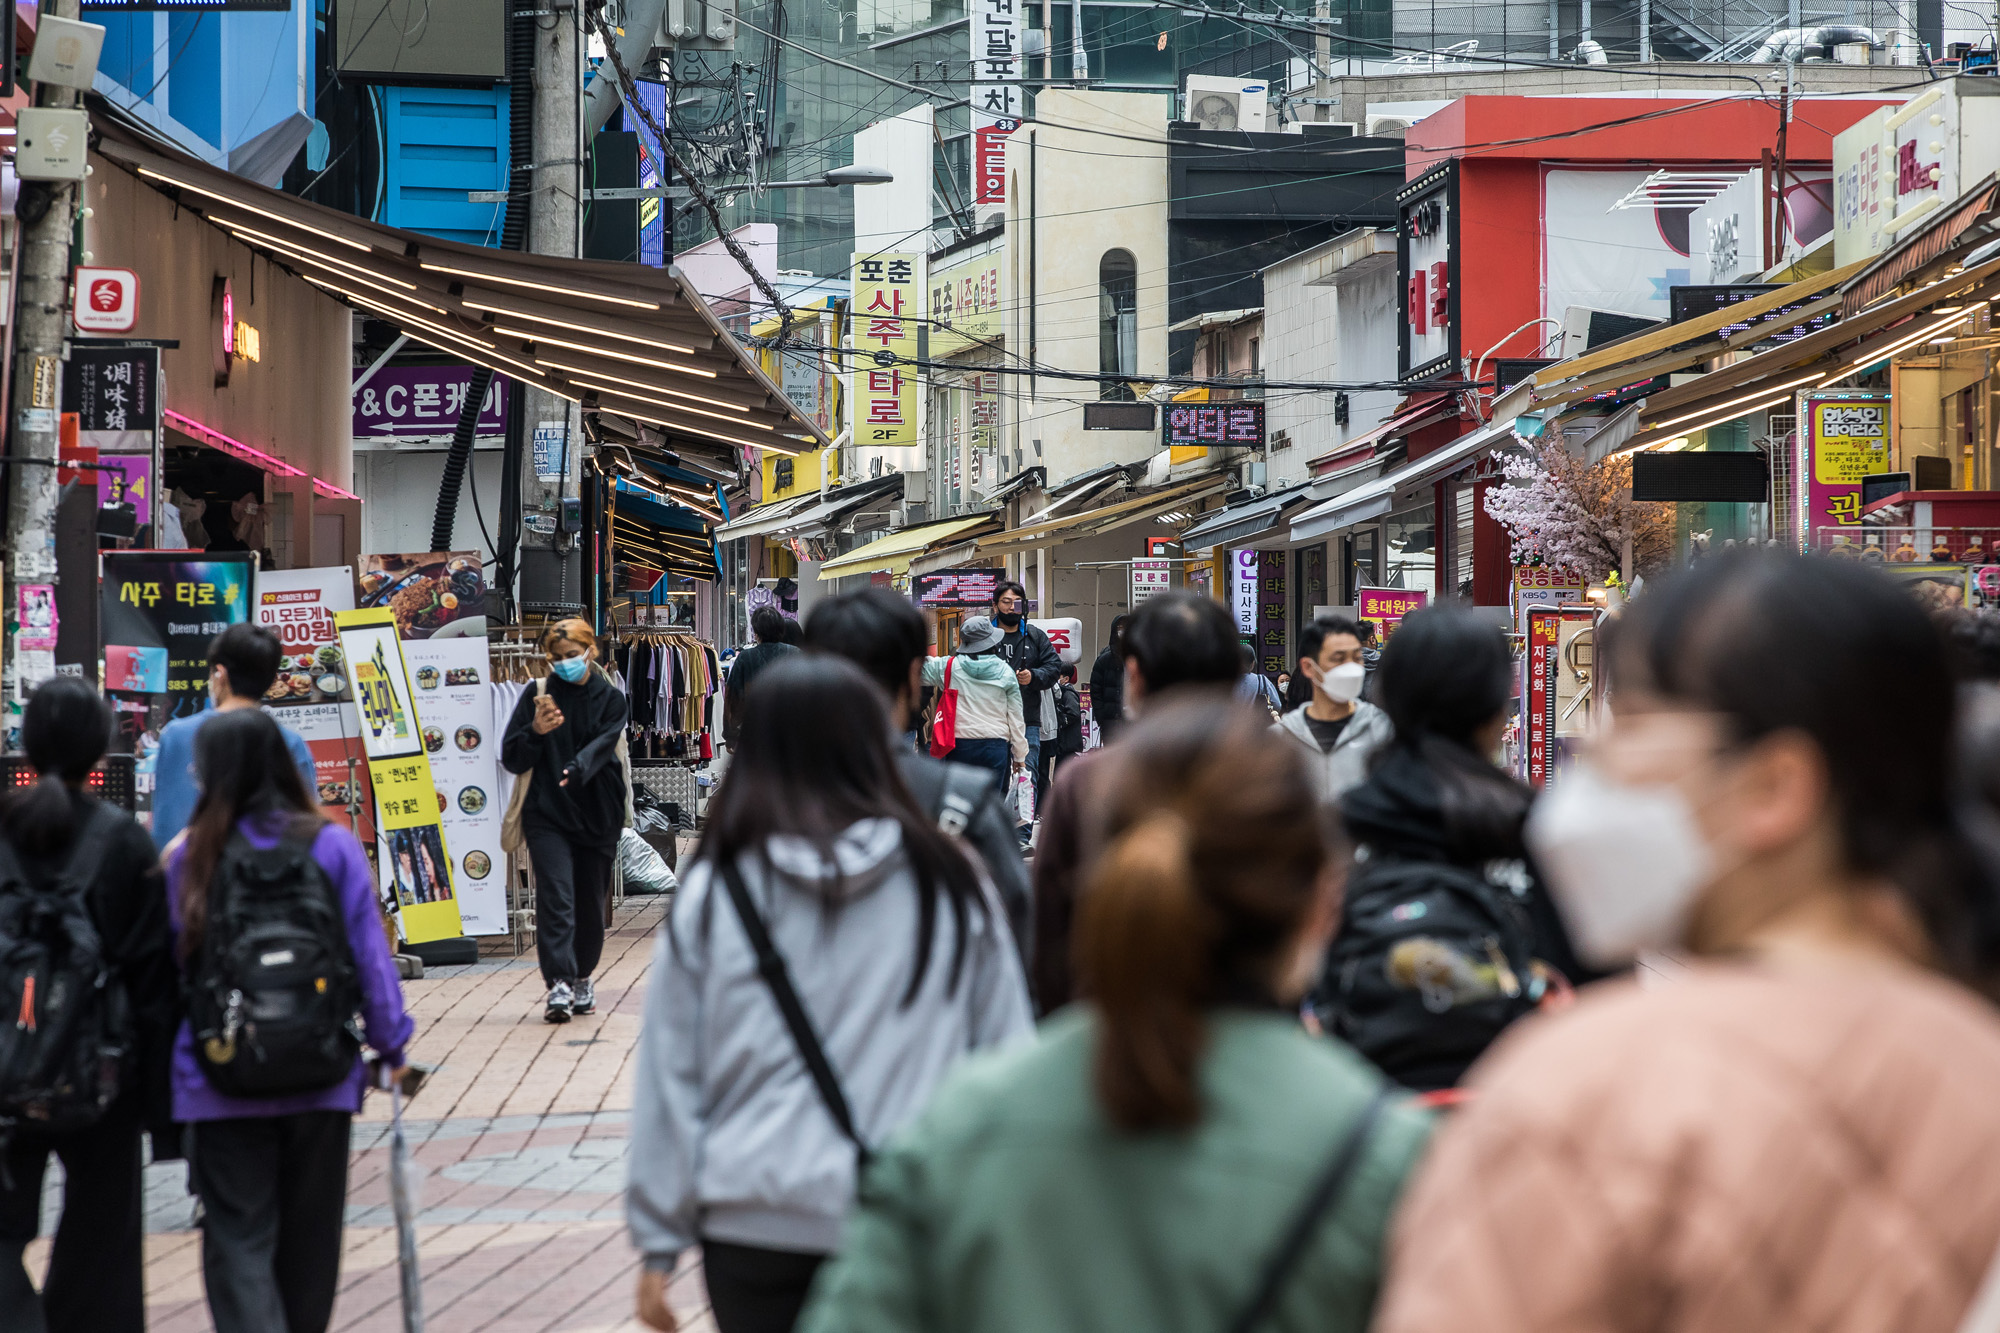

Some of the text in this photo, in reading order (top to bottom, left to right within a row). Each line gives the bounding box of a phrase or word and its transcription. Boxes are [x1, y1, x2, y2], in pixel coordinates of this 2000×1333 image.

[999, 119, 1015, 131] 3층
[1860, 143, 1879, 228] 타로
[859, 259, 912, 285] 포춘
[932, 268, 998, 334] 포춘 사주 타로
[866, 288, 906, 347] 사주
[103, 361, 131, 431] 调味猪
[866, 369, 905, 425] 타로
[535, 430, 546, 440] KT
[872, 429, 898, 440] 2F
[1822, 424, 1884, 437] 바이러스
[921, 573, 997, 602] 2층
[1519, 569, 1580, 586] 방송출연
[120, 582, 161, 607] 사주
[176, 582, 216, 607] 타로
[263, 594, 276, 603] 99
[276, 592, 302, 602] 스테이크
[261, 606, 322, 623] 이 모든게
[1533, 645, 1545, 692] 지성화
[168, 680, 189, 690] SBS
